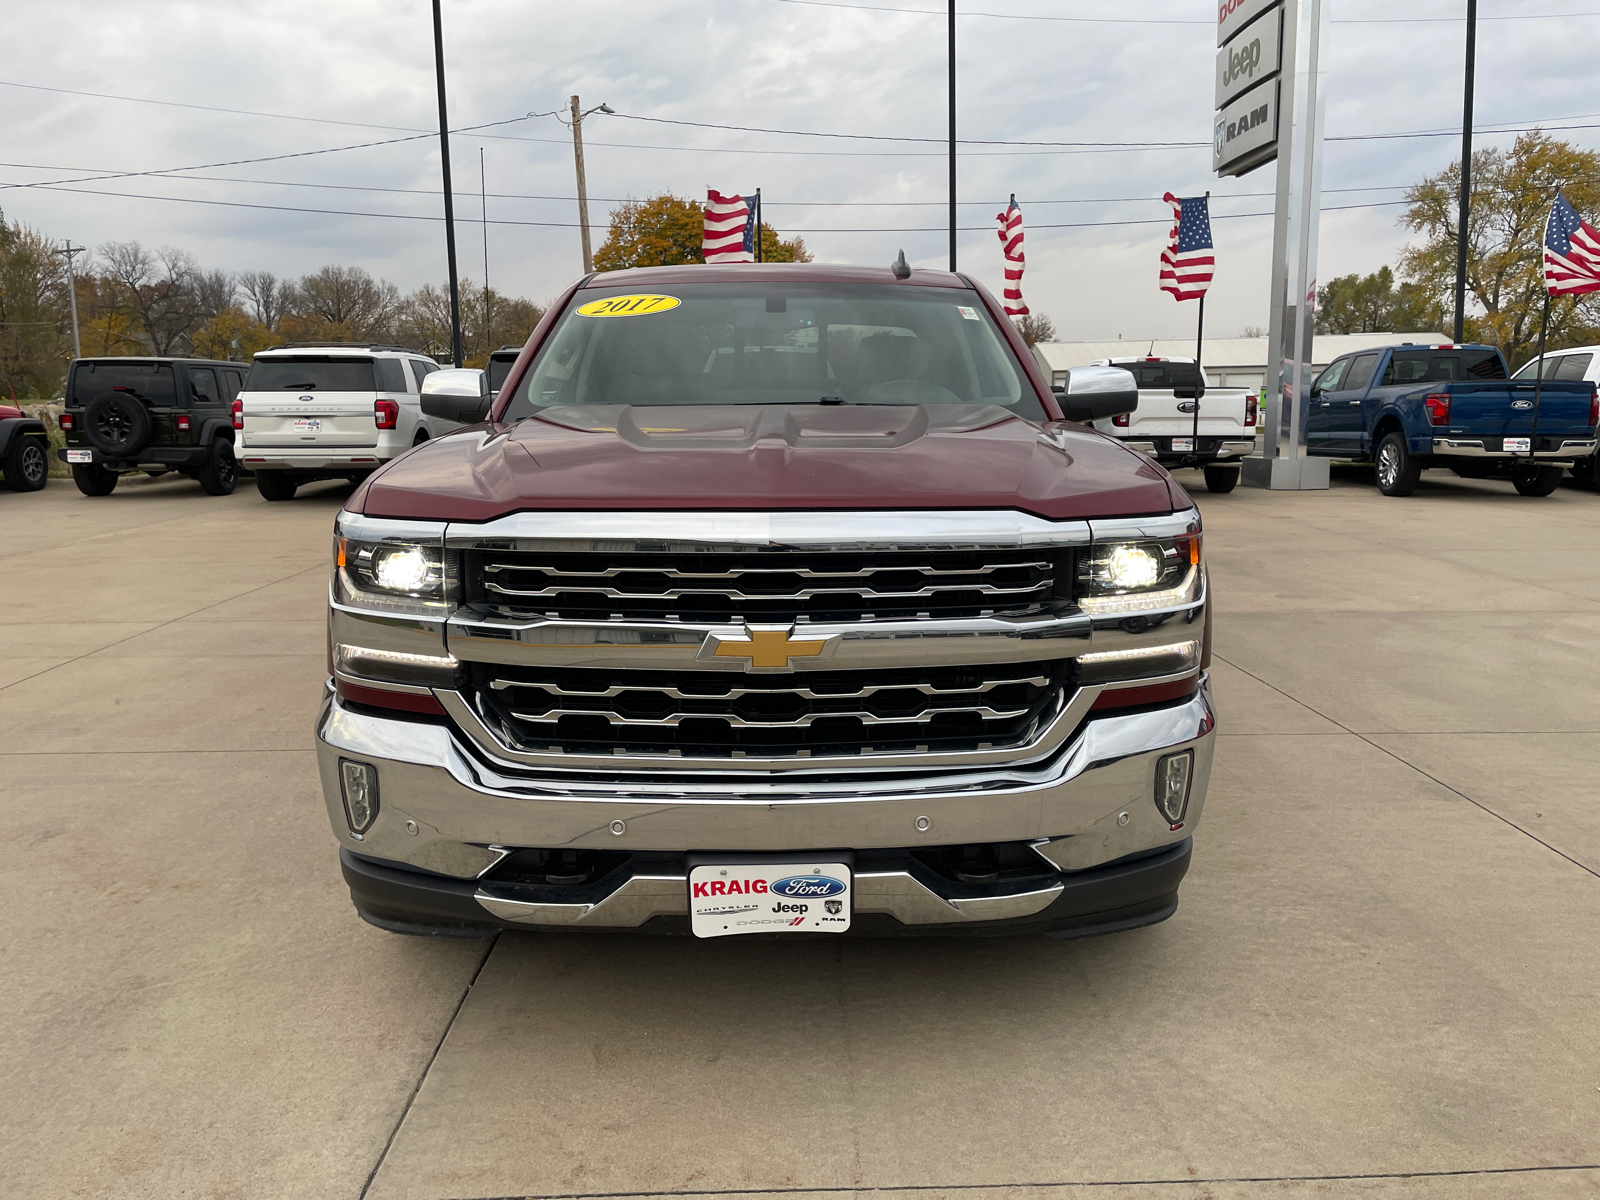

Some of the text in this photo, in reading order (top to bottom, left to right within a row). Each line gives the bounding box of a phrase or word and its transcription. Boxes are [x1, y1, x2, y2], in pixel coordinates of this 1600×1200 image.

[1222, 37, 1261, 87] Jeep
[1226, 103, 1268, 143] RAM
[591, 297, 667, 314] 2017
[693, 879, 831, 898] KRAIG Ford
[696, 902, 809, 914] CHRYSLER Jeep
[736, 918, 796, 926] DODGE
